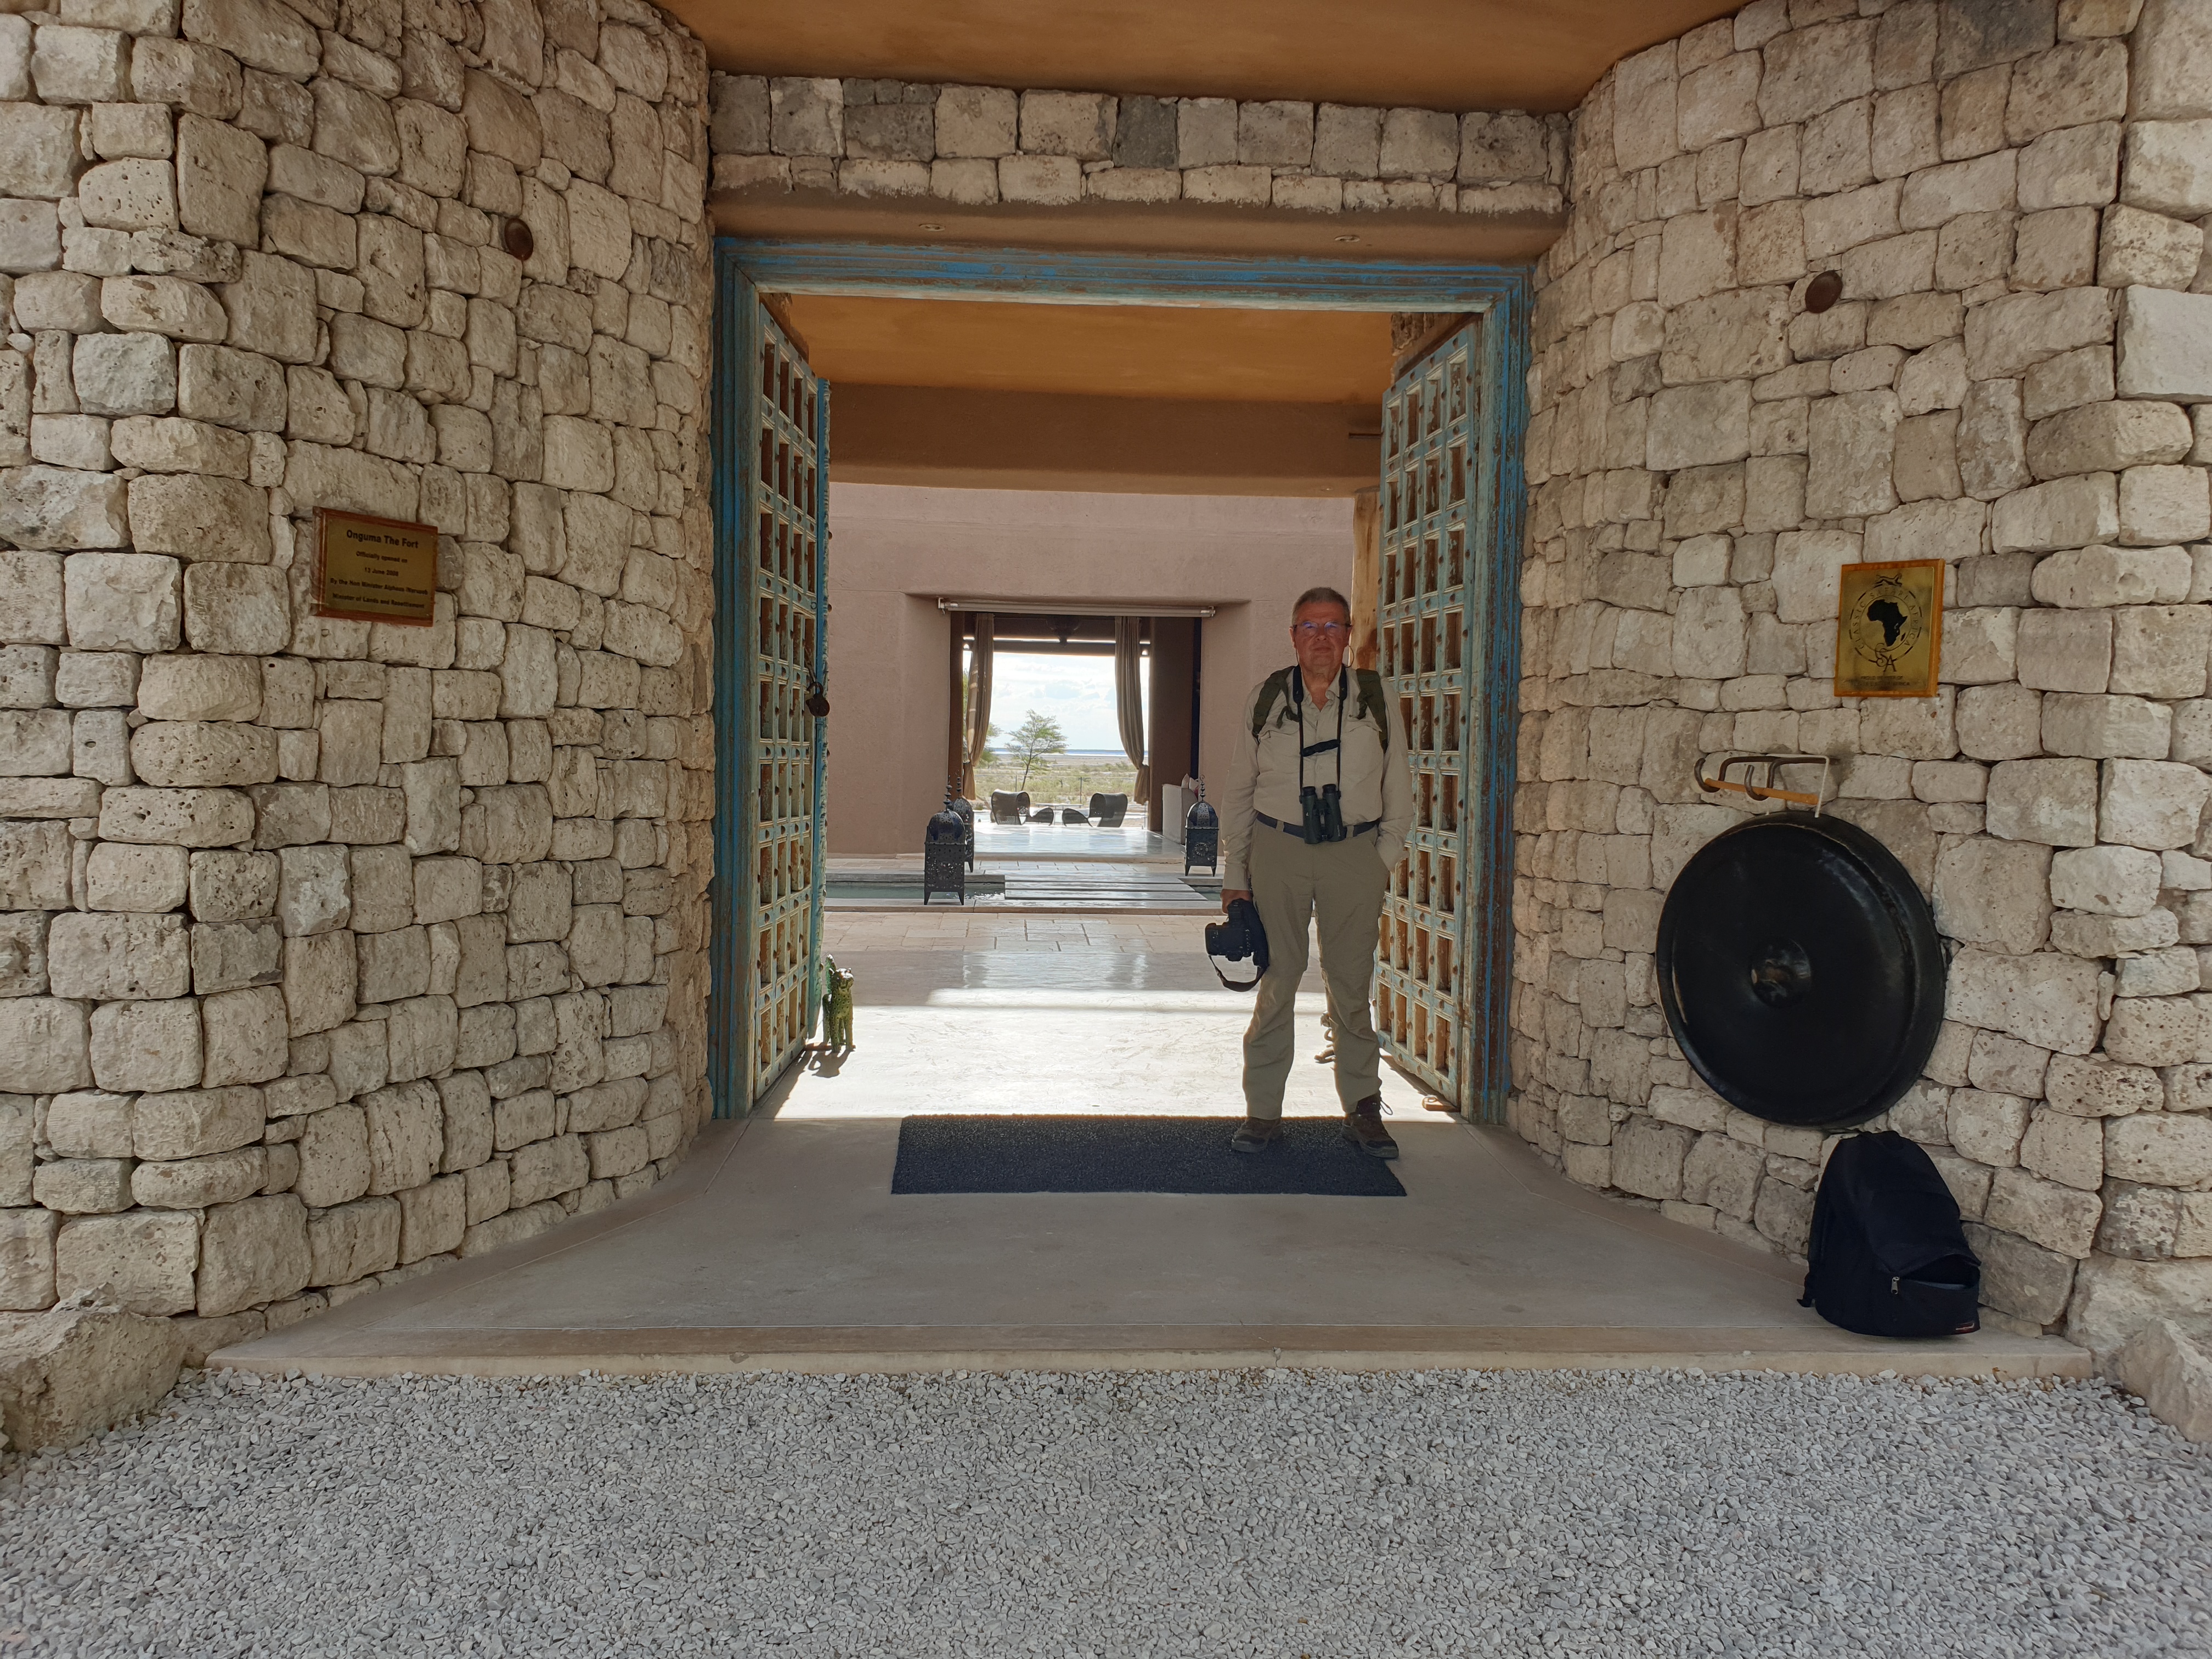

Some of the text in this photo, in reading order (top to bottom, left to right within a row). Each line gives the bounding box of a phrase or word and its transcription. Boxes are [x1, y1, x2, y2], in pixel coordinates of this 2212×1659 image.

[346, 529, 419, 549] Onguma The Fort
[356, 551, 380, 560] Officially
[332, 592, 354, 601] Minister
[1853, 601, 1866, 649] CLASSIC
[1904, 605, 1918, 646] AFRICA
